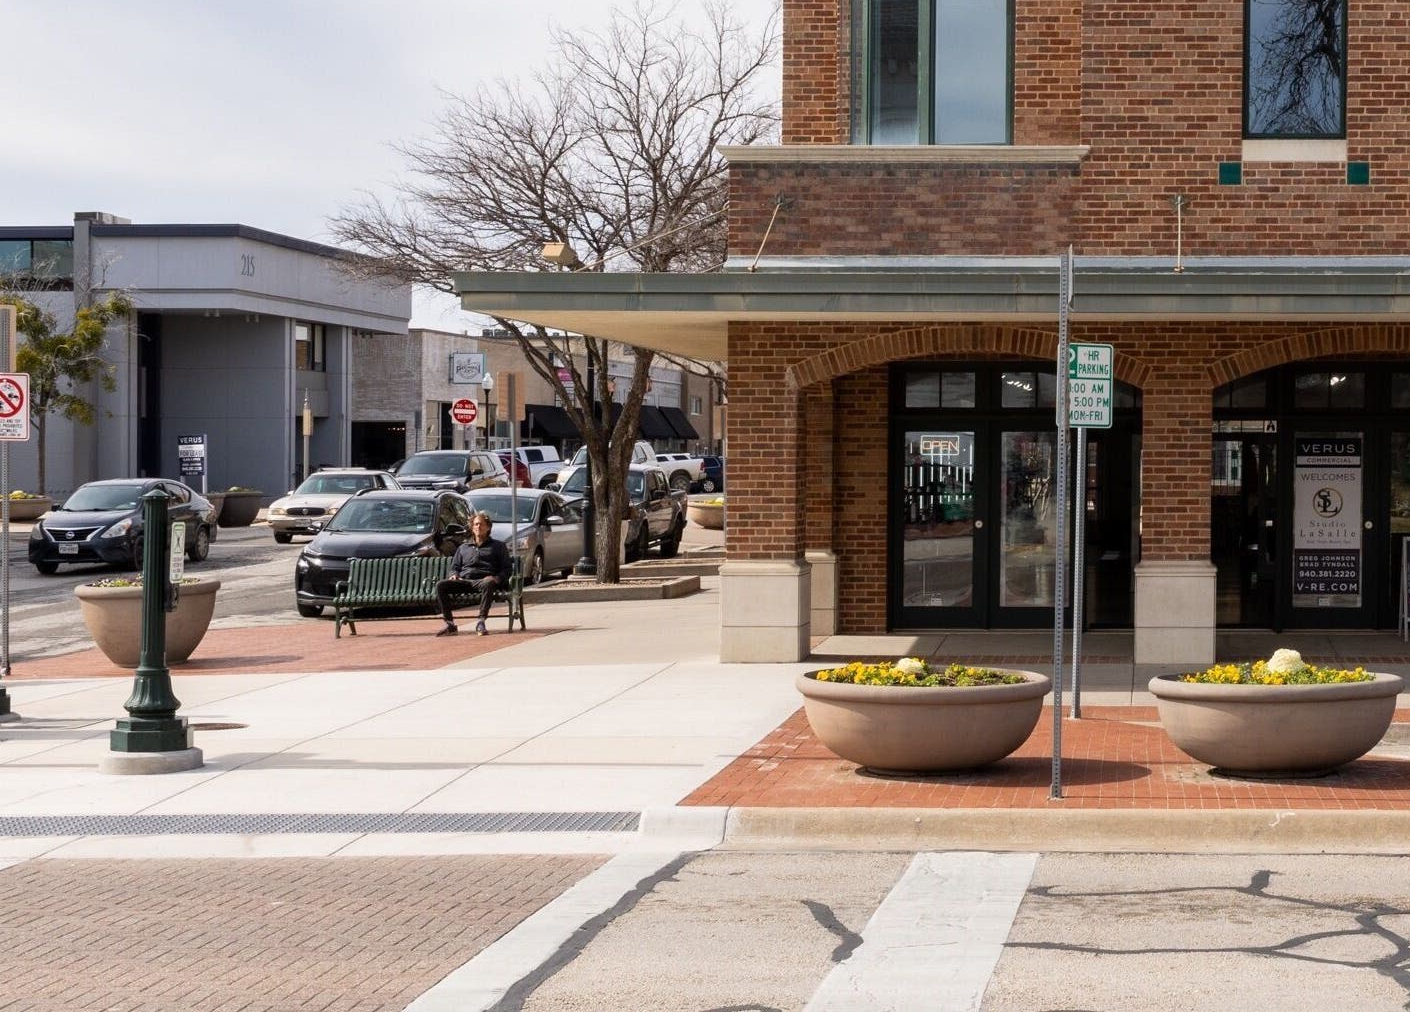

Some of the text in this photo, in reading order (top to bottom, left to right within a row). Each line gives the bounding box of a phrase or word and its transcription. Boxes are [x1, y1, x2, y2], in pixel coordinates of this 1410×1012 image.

[240, 253, 256, 277] 215
[1088, 351, 1100, 361] HR
[1078, 364, 1109, 375] PARKING
[1091, 384, 1104, 394] AM
[1074, 397, 1109, 408] 5:00 PM
[922, 440, 959, 452] OPEN
[1301, 444, 1356, 454] VERUS
[1301, 473, 1356, 481] WELCOMES
[1299, 570, 1356, 578] 940.381.2220
[1296, 582, 1358, 592] V-RE.COM
